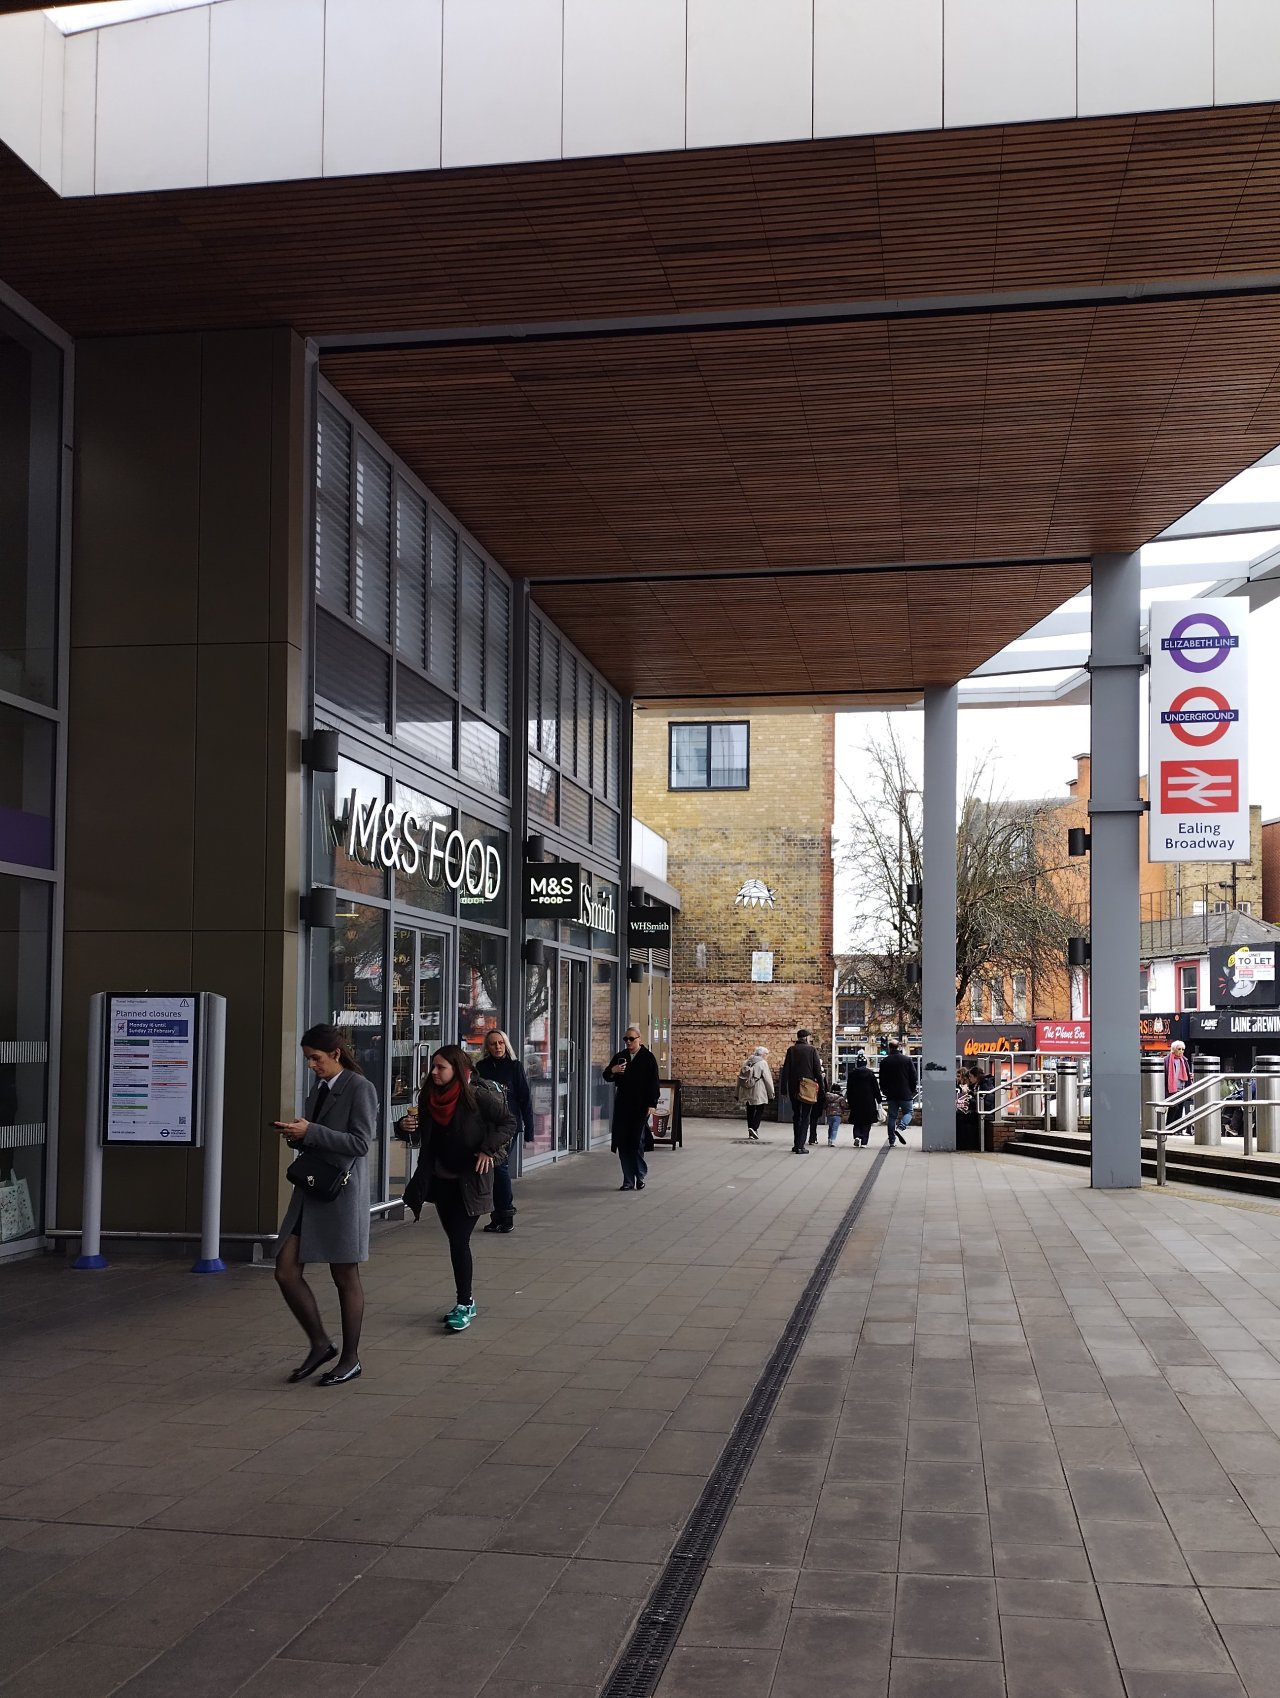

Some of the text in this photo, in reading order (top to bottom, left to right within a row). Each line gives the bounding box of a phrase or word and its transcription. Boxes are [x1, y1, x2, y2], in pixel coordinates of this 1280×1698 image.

[1164, 637, 1236, 649] ELIZABETH LINE
[1164, 711, 1235, 722] UNDERGROUND
[1178, 822, 1221, 836] Ealing
[349, 788, 502, 899] M&S FOOD
[1165, 838, 1235, 851] Broadway
[530, 877, 573, 896] M&S
[539, 896, 563, 904] FOOD
[630, 921, 669, 930] WHSmith
[1238, 957, 1272, 965] TO LET
[116, 1010, 182, 1018] Planned closures
[1230, 1016, 1252, 1033] LAINE
[1043, 1025, 1086, 1039] The Phone Box
